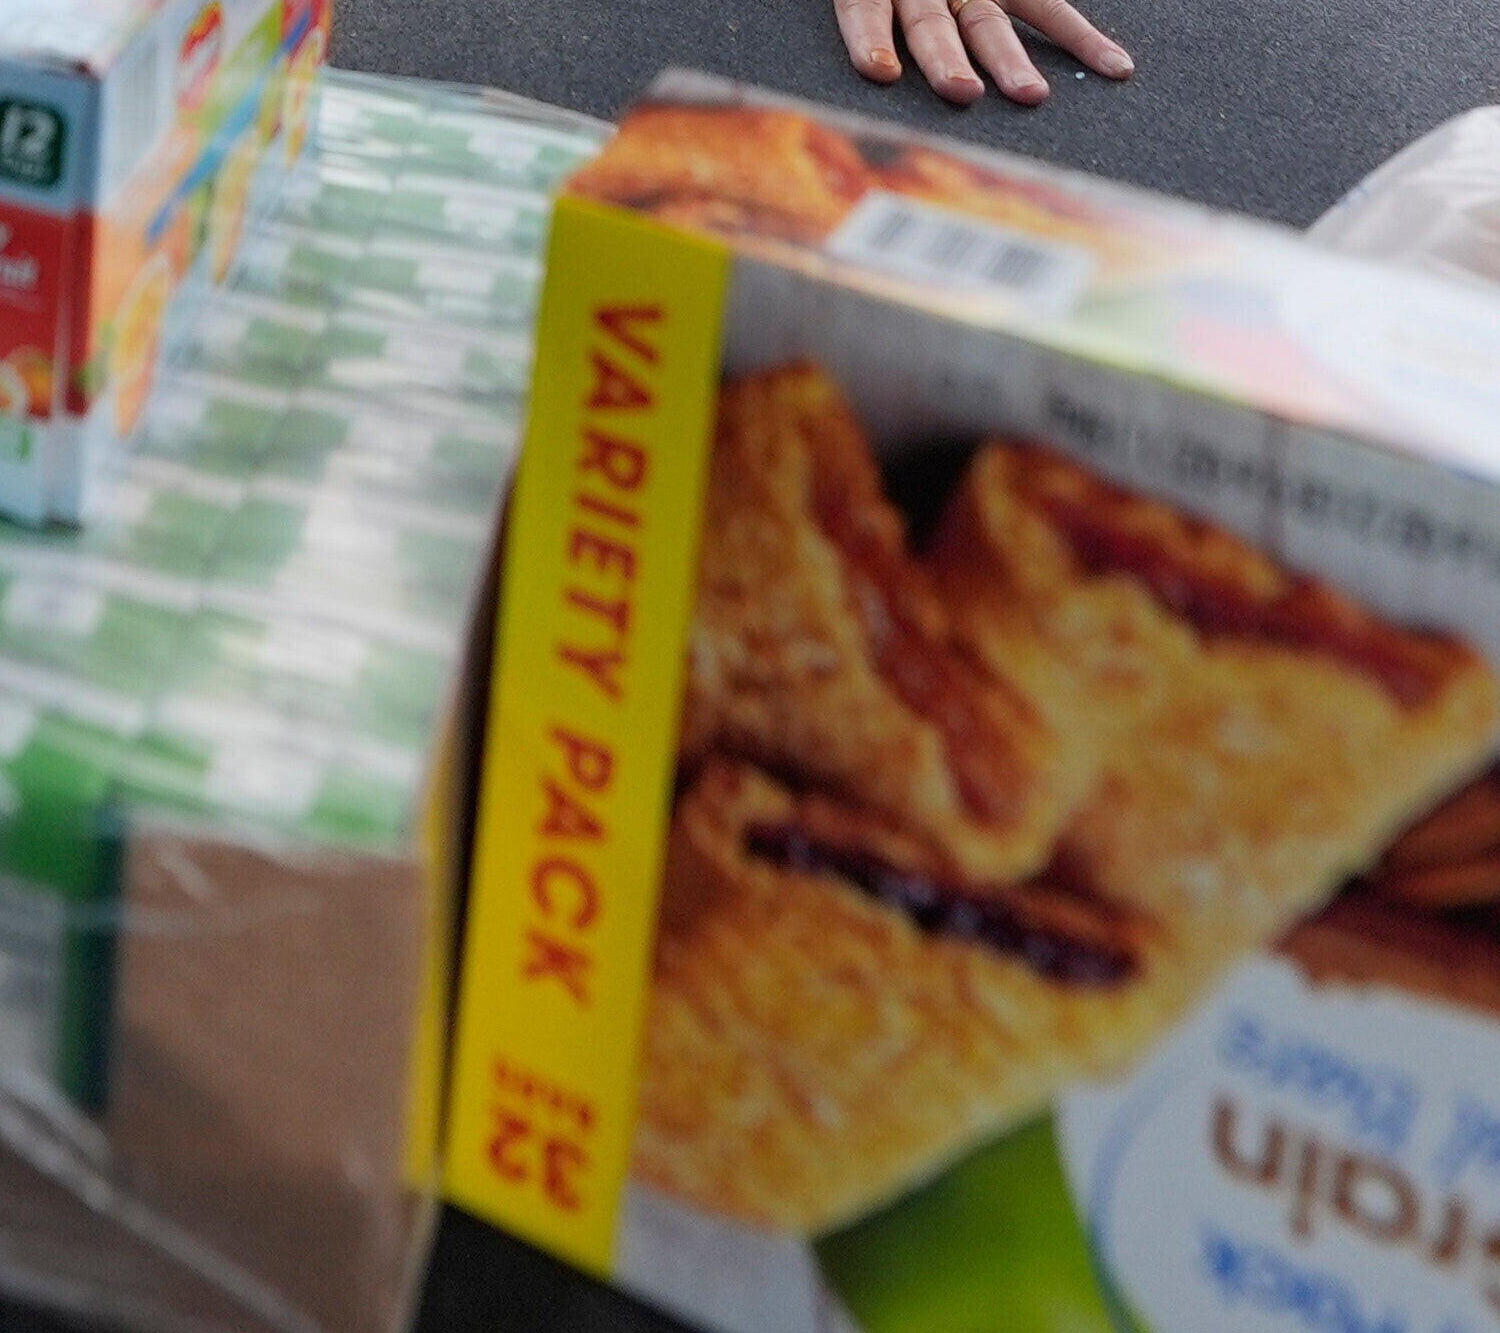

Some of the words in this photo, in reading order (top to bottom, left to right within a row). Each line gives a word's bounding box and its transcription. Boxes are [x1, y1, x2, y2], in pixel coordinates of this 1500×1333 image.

[1, 103, 56, 157] 12
[557, 299, 666, 707] VARIETY
[520, 724, 617, 1008] PACK
